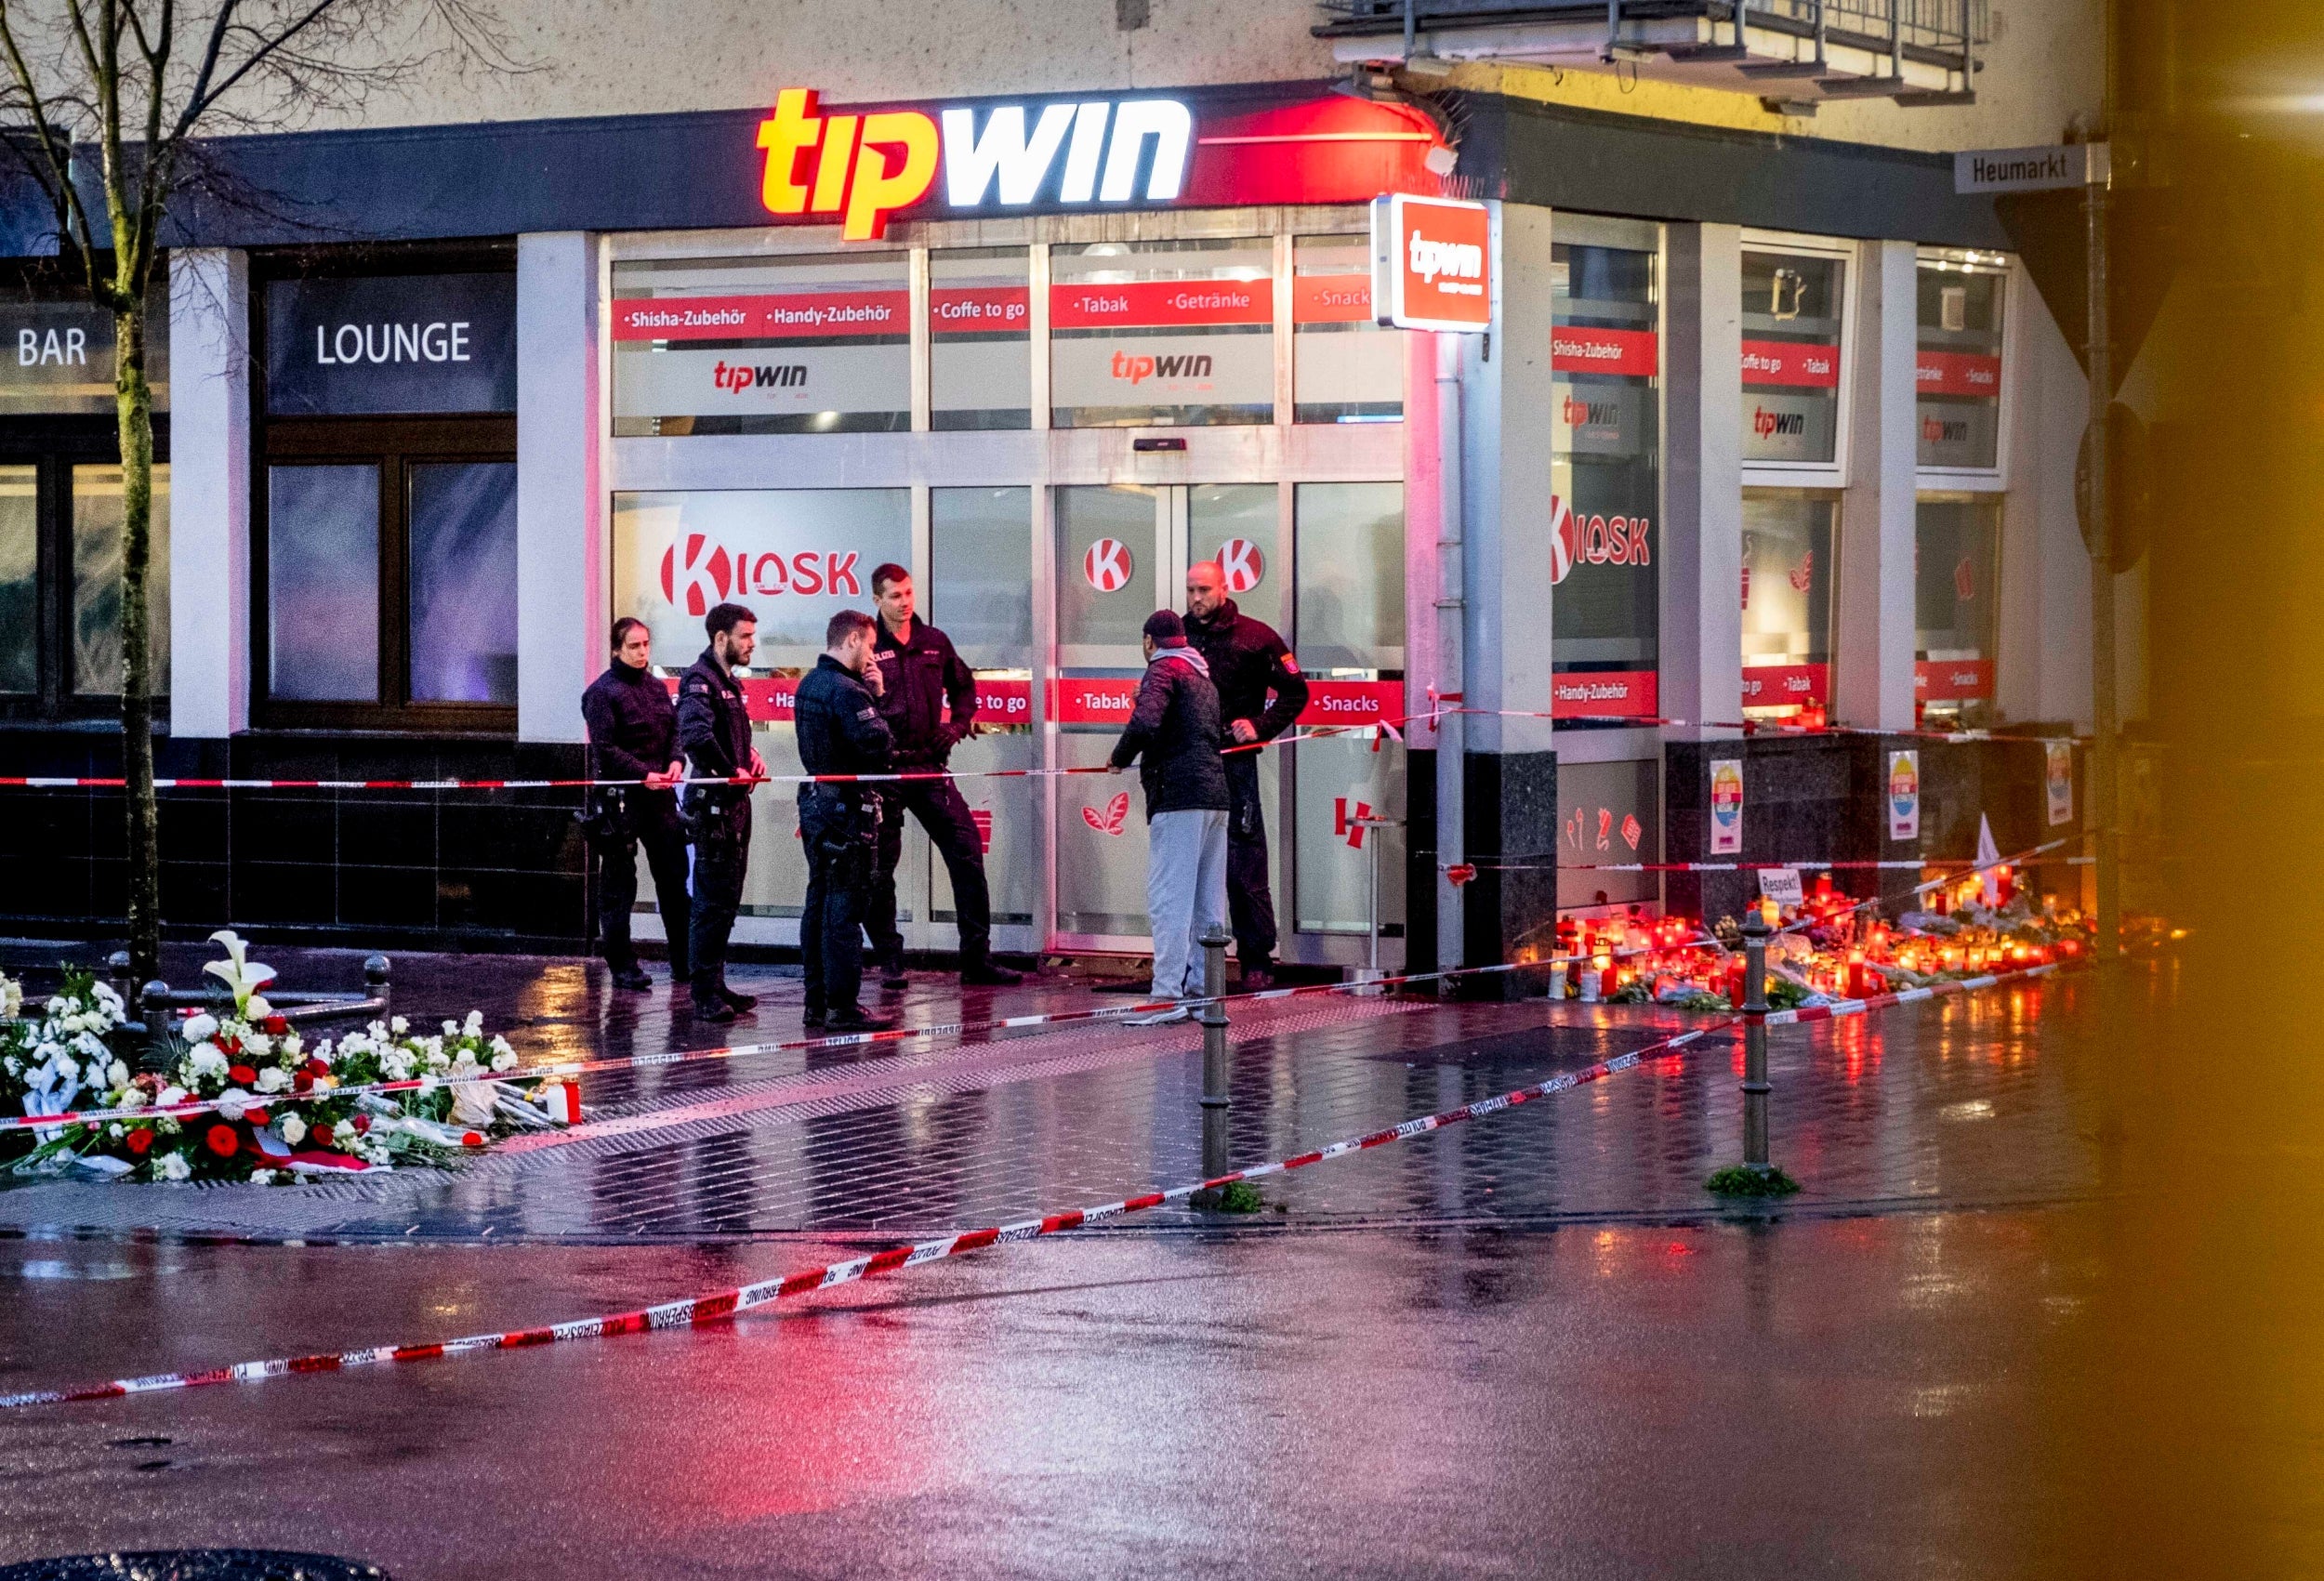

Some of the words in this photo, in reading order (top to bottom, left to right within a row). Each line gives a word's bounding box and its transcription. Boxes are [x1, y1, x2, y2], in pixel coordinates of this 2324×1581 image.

[756, 87, 1193, 241] tipwin
[1974, 153, 2067, 183] Heumarkt
[1409, 230, 1482, 283] tipwin
[940, 299, 982, 320] Coffe
[985, 302, 1002, 317] to
[1006, 301, 1026, 322] go
[1081, 296, 1129, 313] Tabak
[1175, 292, 1250, 310] Getränke
[1322, 287, 1371, 307] Snack
[631, 308, 746, 327] Shisha-Zubehör
[773, 303, 891, 326] Handy-Zubehör
[18, 328, 87, 367] BAR
[317, 322, 471, 365] LOUNGE
[1553, 339, 1623, 361] Shisha-Zubehör
[715, 360, 807, 395] tipwin
[1111, 349, 1213, 385] tipwin
[1806, 358, 1830, 374] Tabak
[1564, 394, 1618, 431] tipwin
[1754, 405, 1804, 441] tipwin
[1922, 416, 1968, 445] tipwin
[661, 533, 861, 616] KIOSK
[1087, 538, 1130, 592] K
[1559, 683, 1629, 704] Handy-Zubehör
[1787, 676, 1812, 692] Tabak
[986, 694, 1004, 709] to
[1008, 696, 1026, 713] go
[1085, 692, 1130, 710] Tabak
[1322, 694, 1380, 713] Snacks
